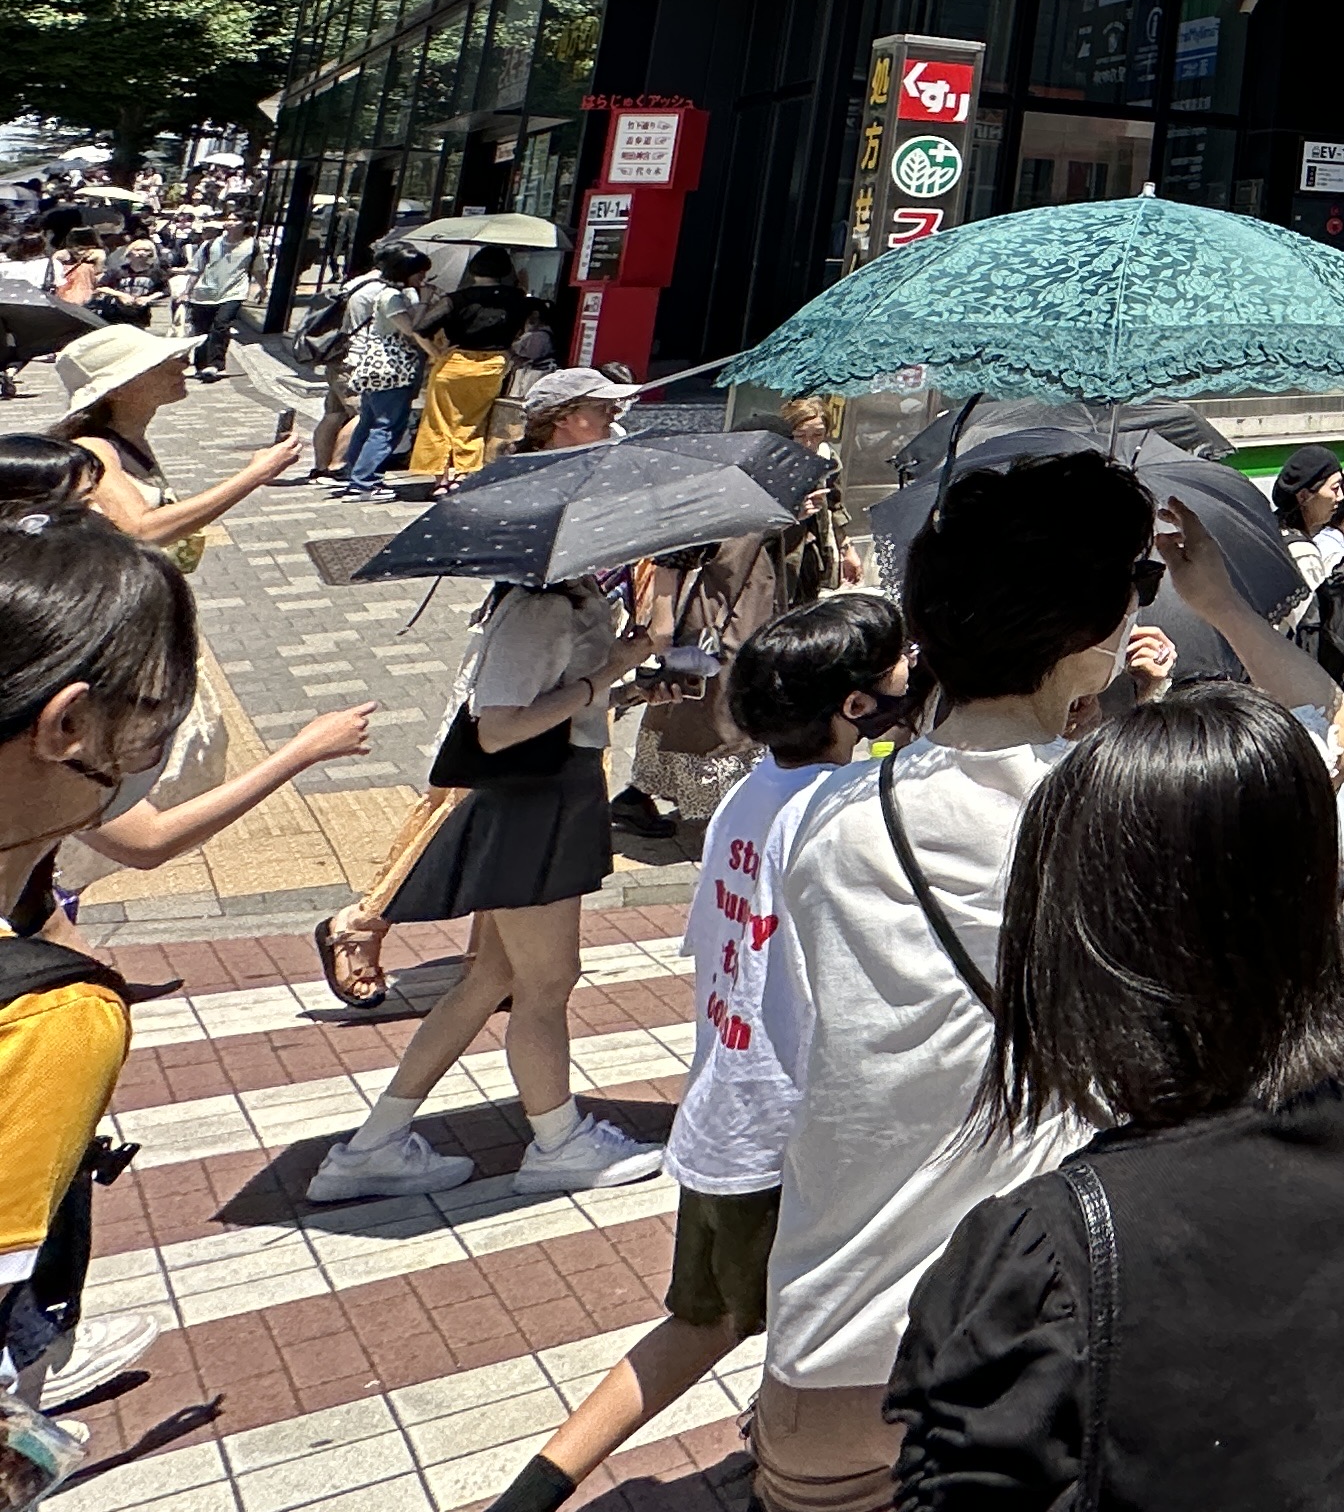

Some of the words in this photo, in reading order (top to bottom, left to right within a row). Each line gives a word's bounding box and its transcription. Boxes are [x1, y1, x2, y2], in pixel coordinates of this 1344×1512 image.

[582, 94, 695, 109] はらじゅくアッシュ
[903, 62, 971, 123] くすり
